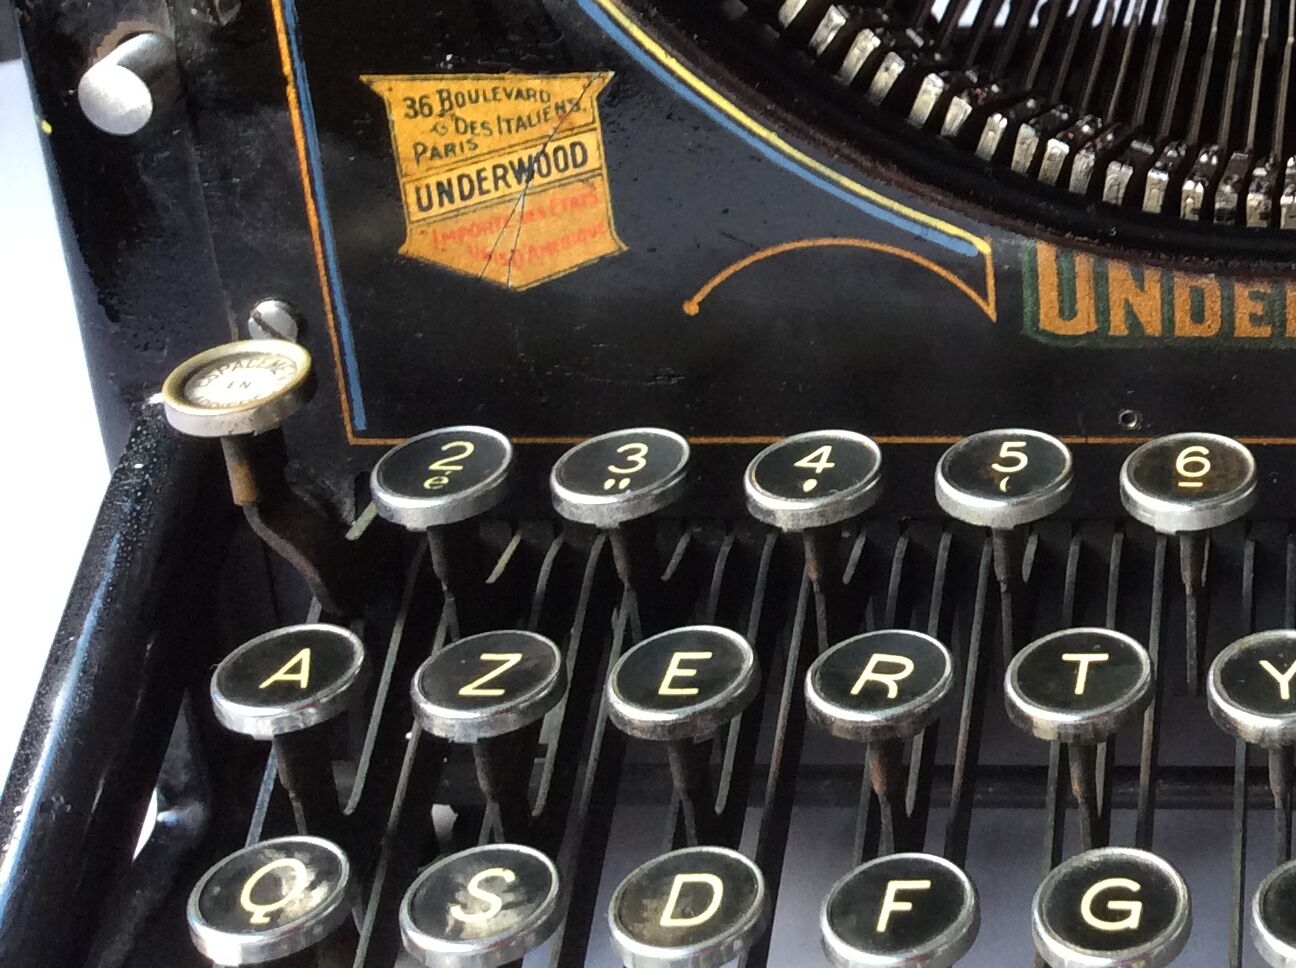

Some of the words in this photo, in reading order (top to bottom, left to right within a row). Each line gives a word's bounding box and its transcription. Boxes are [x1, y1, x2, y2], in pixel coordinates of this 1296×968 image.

[402, 95, 434, 120] 36
[436, 87, 552, 118] BOULEVARD
[452, 114, 492, 137] DES
[412, 138, 479, 165] PARIS
[414, 140, 589, 213] UNDERWOOD
[428, 440, 475, 471] 2
[607, 442, 649, 474] 3
[793, 445, 836, 474] 4
[991, 441, 1028, 473] 5
[1175, 445, 1211, 478] 6
[258, 647, 311, 689] A
[458, 651, 525, 697] Z
[658, 650, 714, 697] E
[850, 653, 915, 699] R
[1061, 653, 1109, 695] T
[240, 856, 303, 925] Q
[449, 867, 517, 925] S
[658, 872, 724, 929] D
[876, 879, 932, 933] F
[1080, 877, 1143, 931] G
